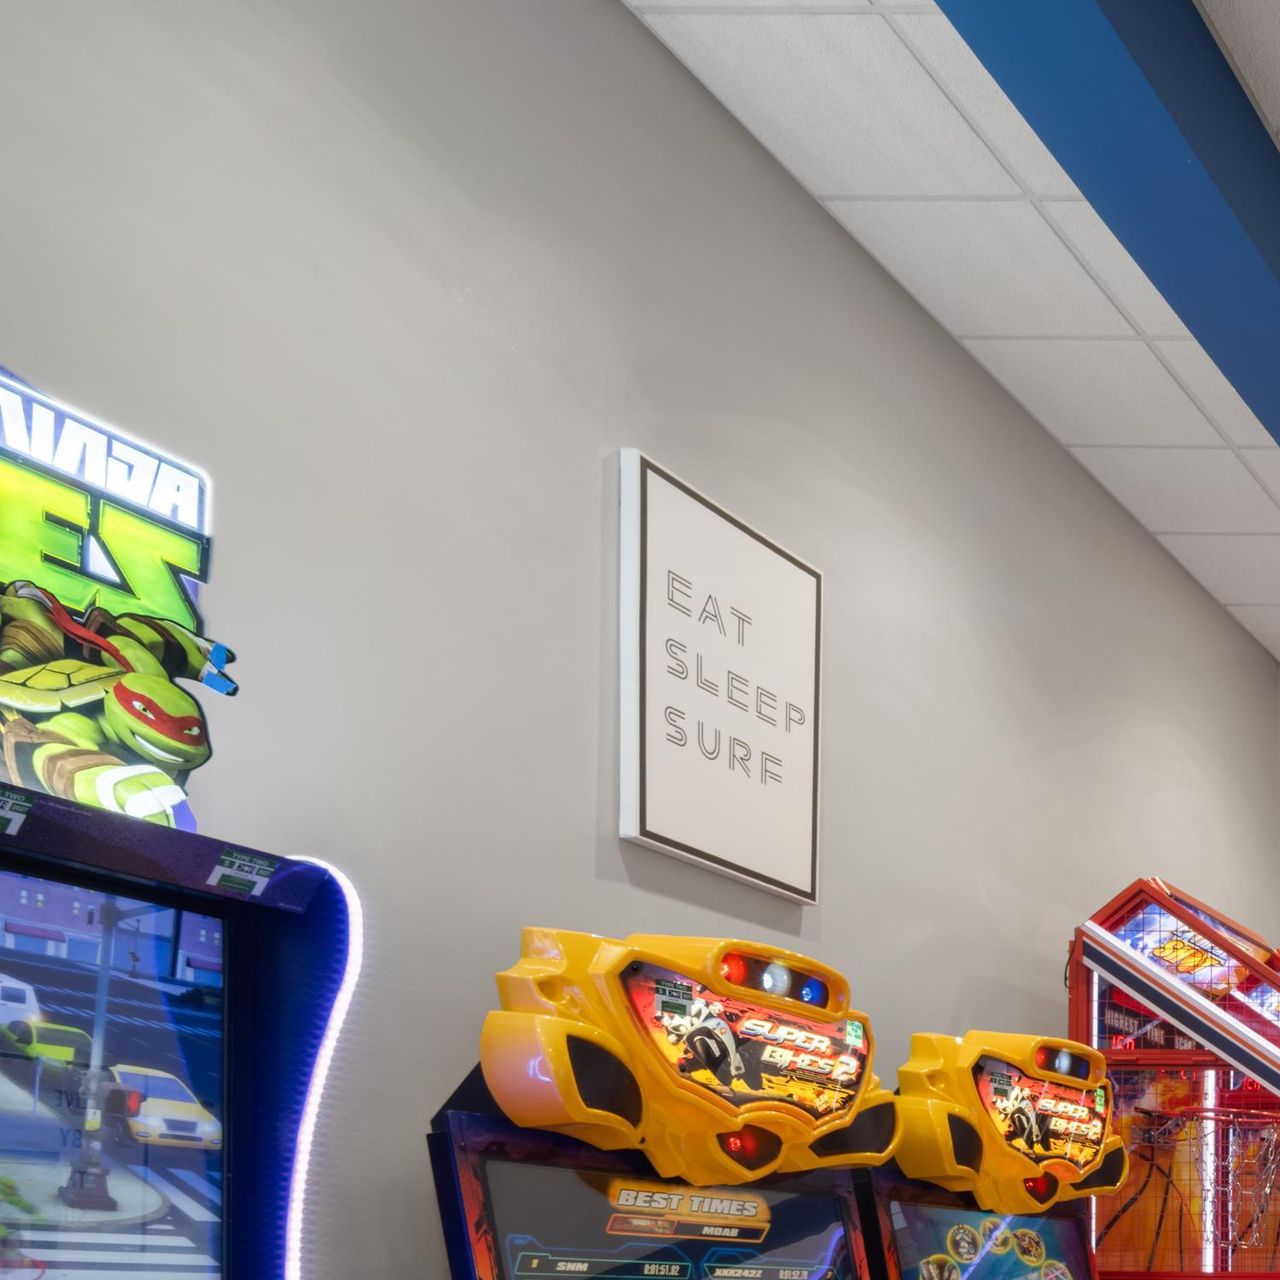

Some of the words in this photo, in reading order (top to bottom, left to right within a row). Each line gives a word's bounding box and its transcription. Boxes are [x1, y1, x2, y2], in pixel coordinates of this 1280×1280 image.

[667, 569, 752, 647] EAT
[665, 638, 806, 734] SLEEP
[664, 705, 783, 785] SURF
[739, 1019, 831, 1052] SUPER
[761, 1046, 833, 1076] BIKES
[833, 1055, 859, 1081] 2
[1039, 1098, 1088, 1119] SUPER
[618, 1189, 683, 1210] BEST
[689, 1196, 758, 1217] TIMES
[702, 1226, 739, 1237] MOAB
[531, 1259, 539, 1268] 1
